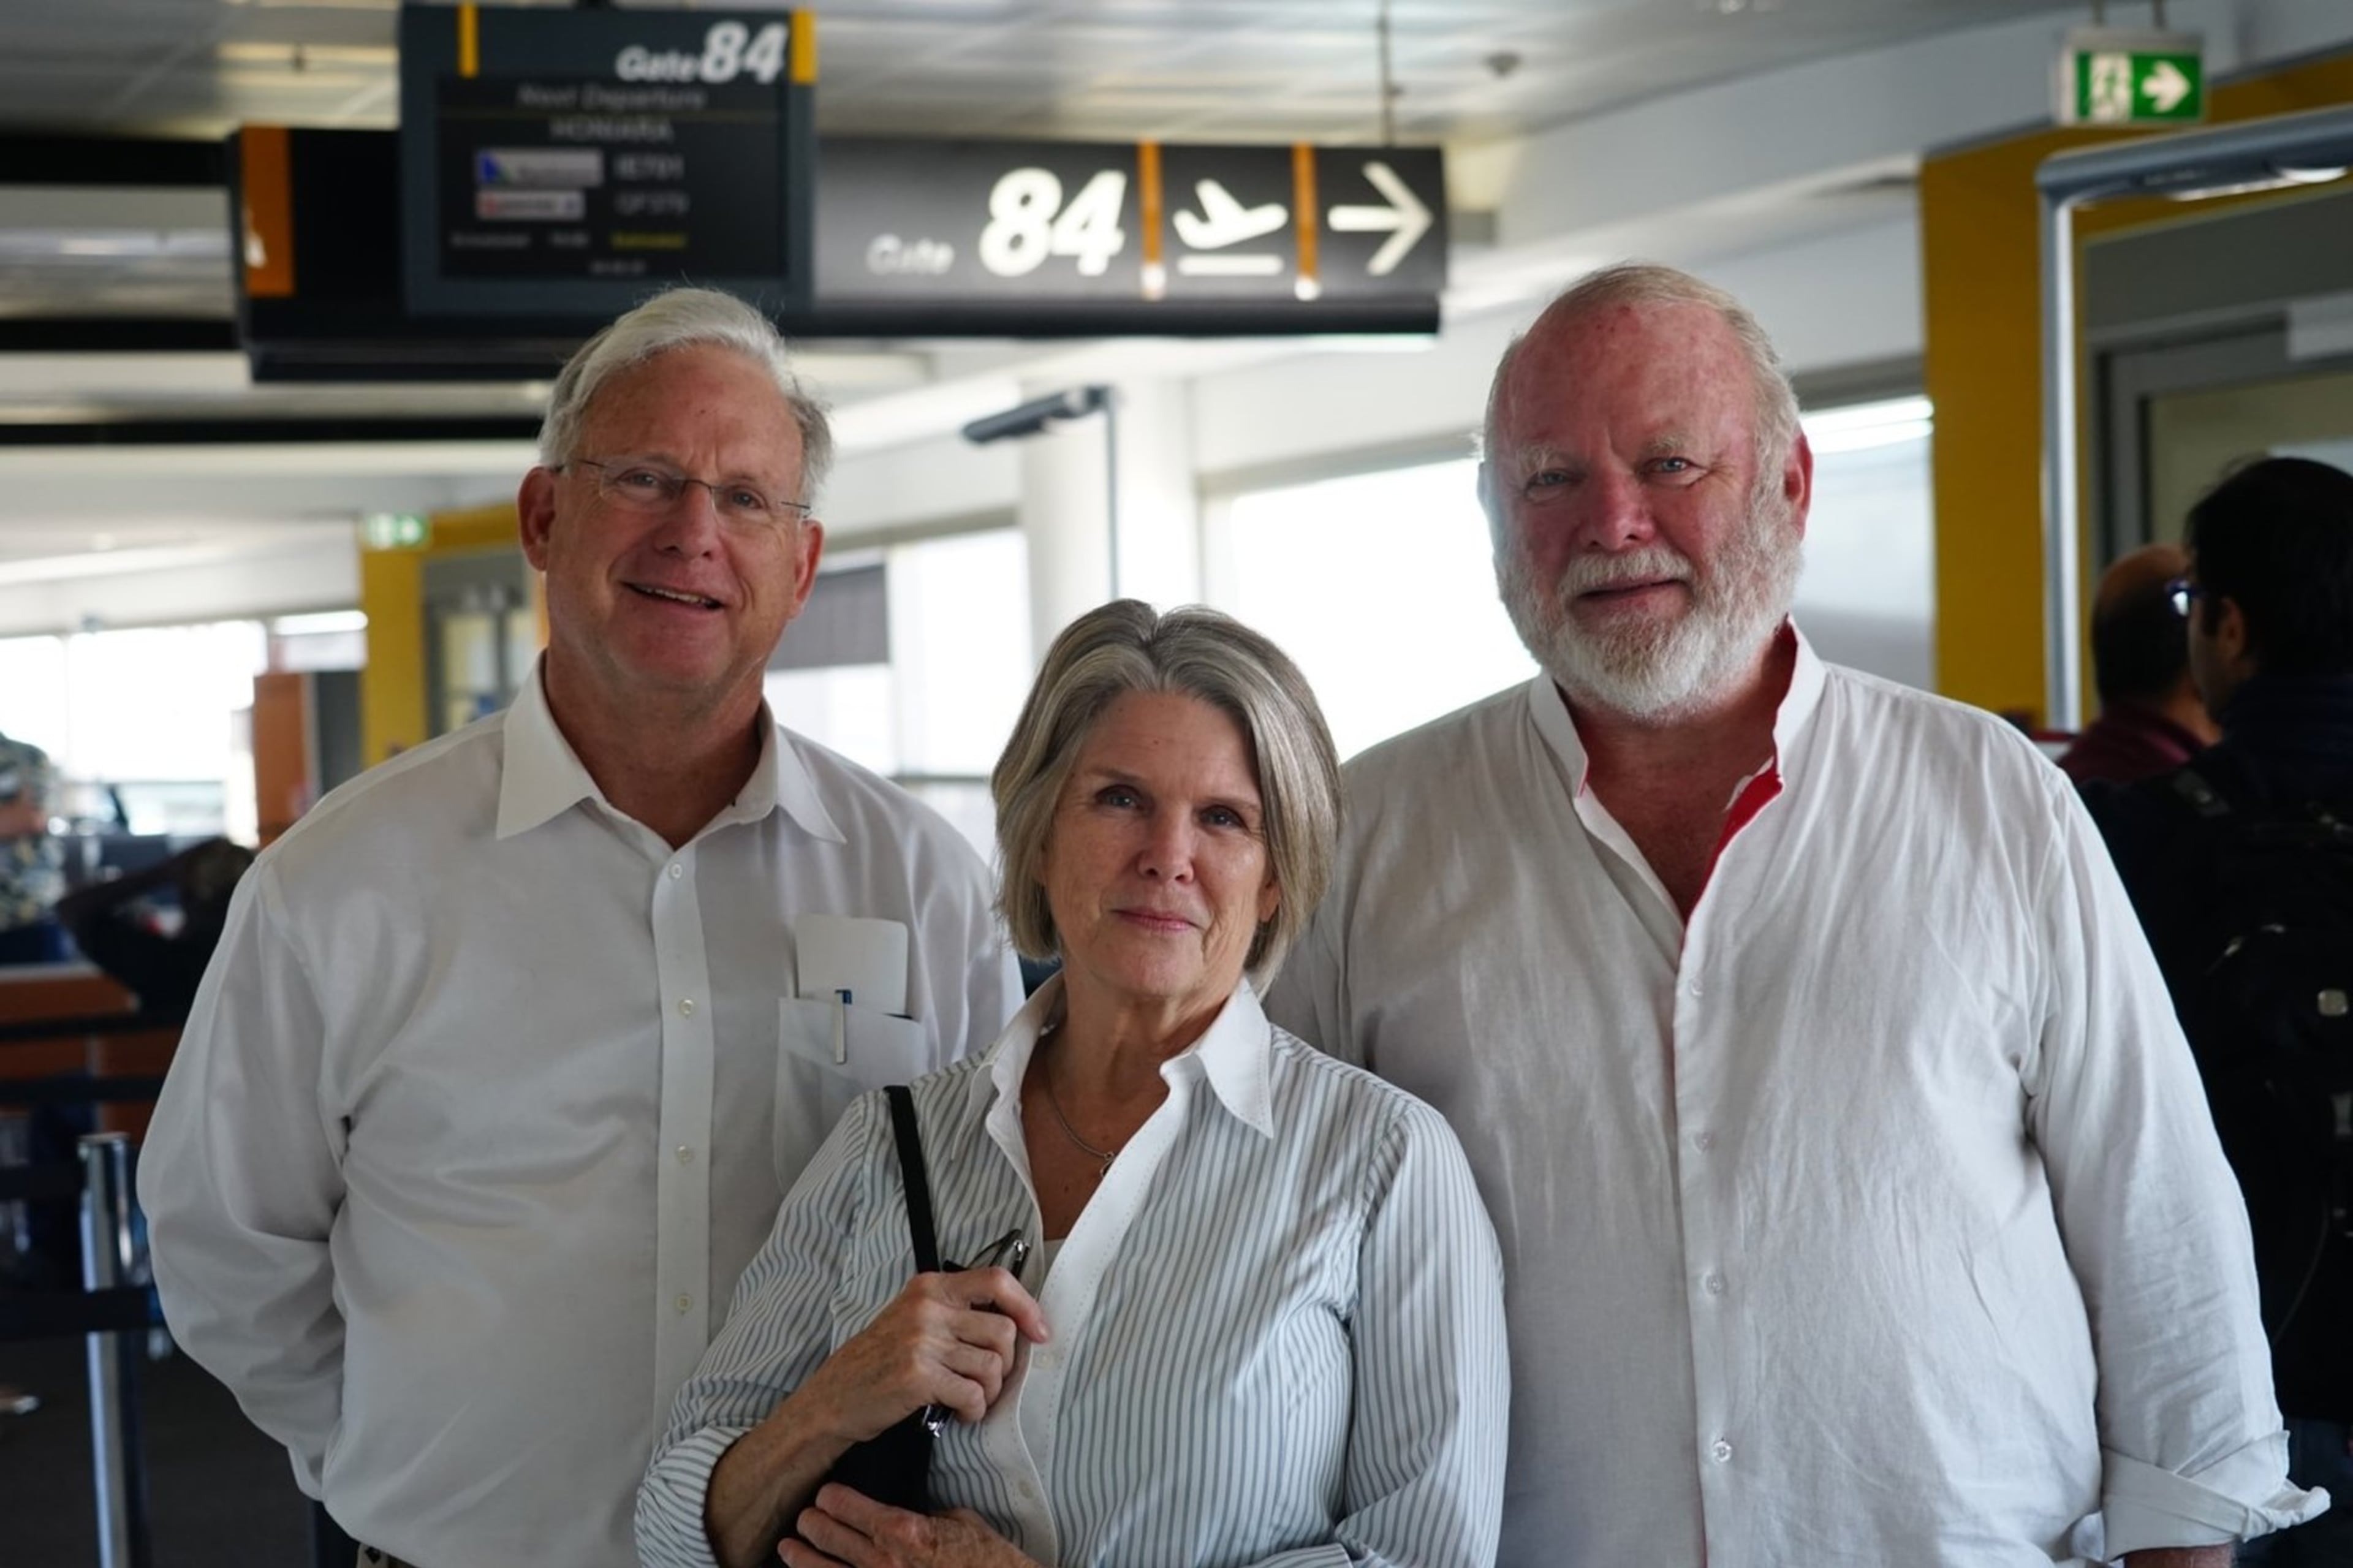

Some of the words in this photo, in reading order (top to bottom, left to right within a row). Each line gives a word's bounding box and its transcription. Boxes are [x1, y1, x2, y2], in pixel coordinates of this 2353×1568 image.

[616, 45, 700, 81] Gate
[700, 21, 787, 83] 84
[865, 233, 955, 275] Gate
[979, 167, 1126, 277] 84
